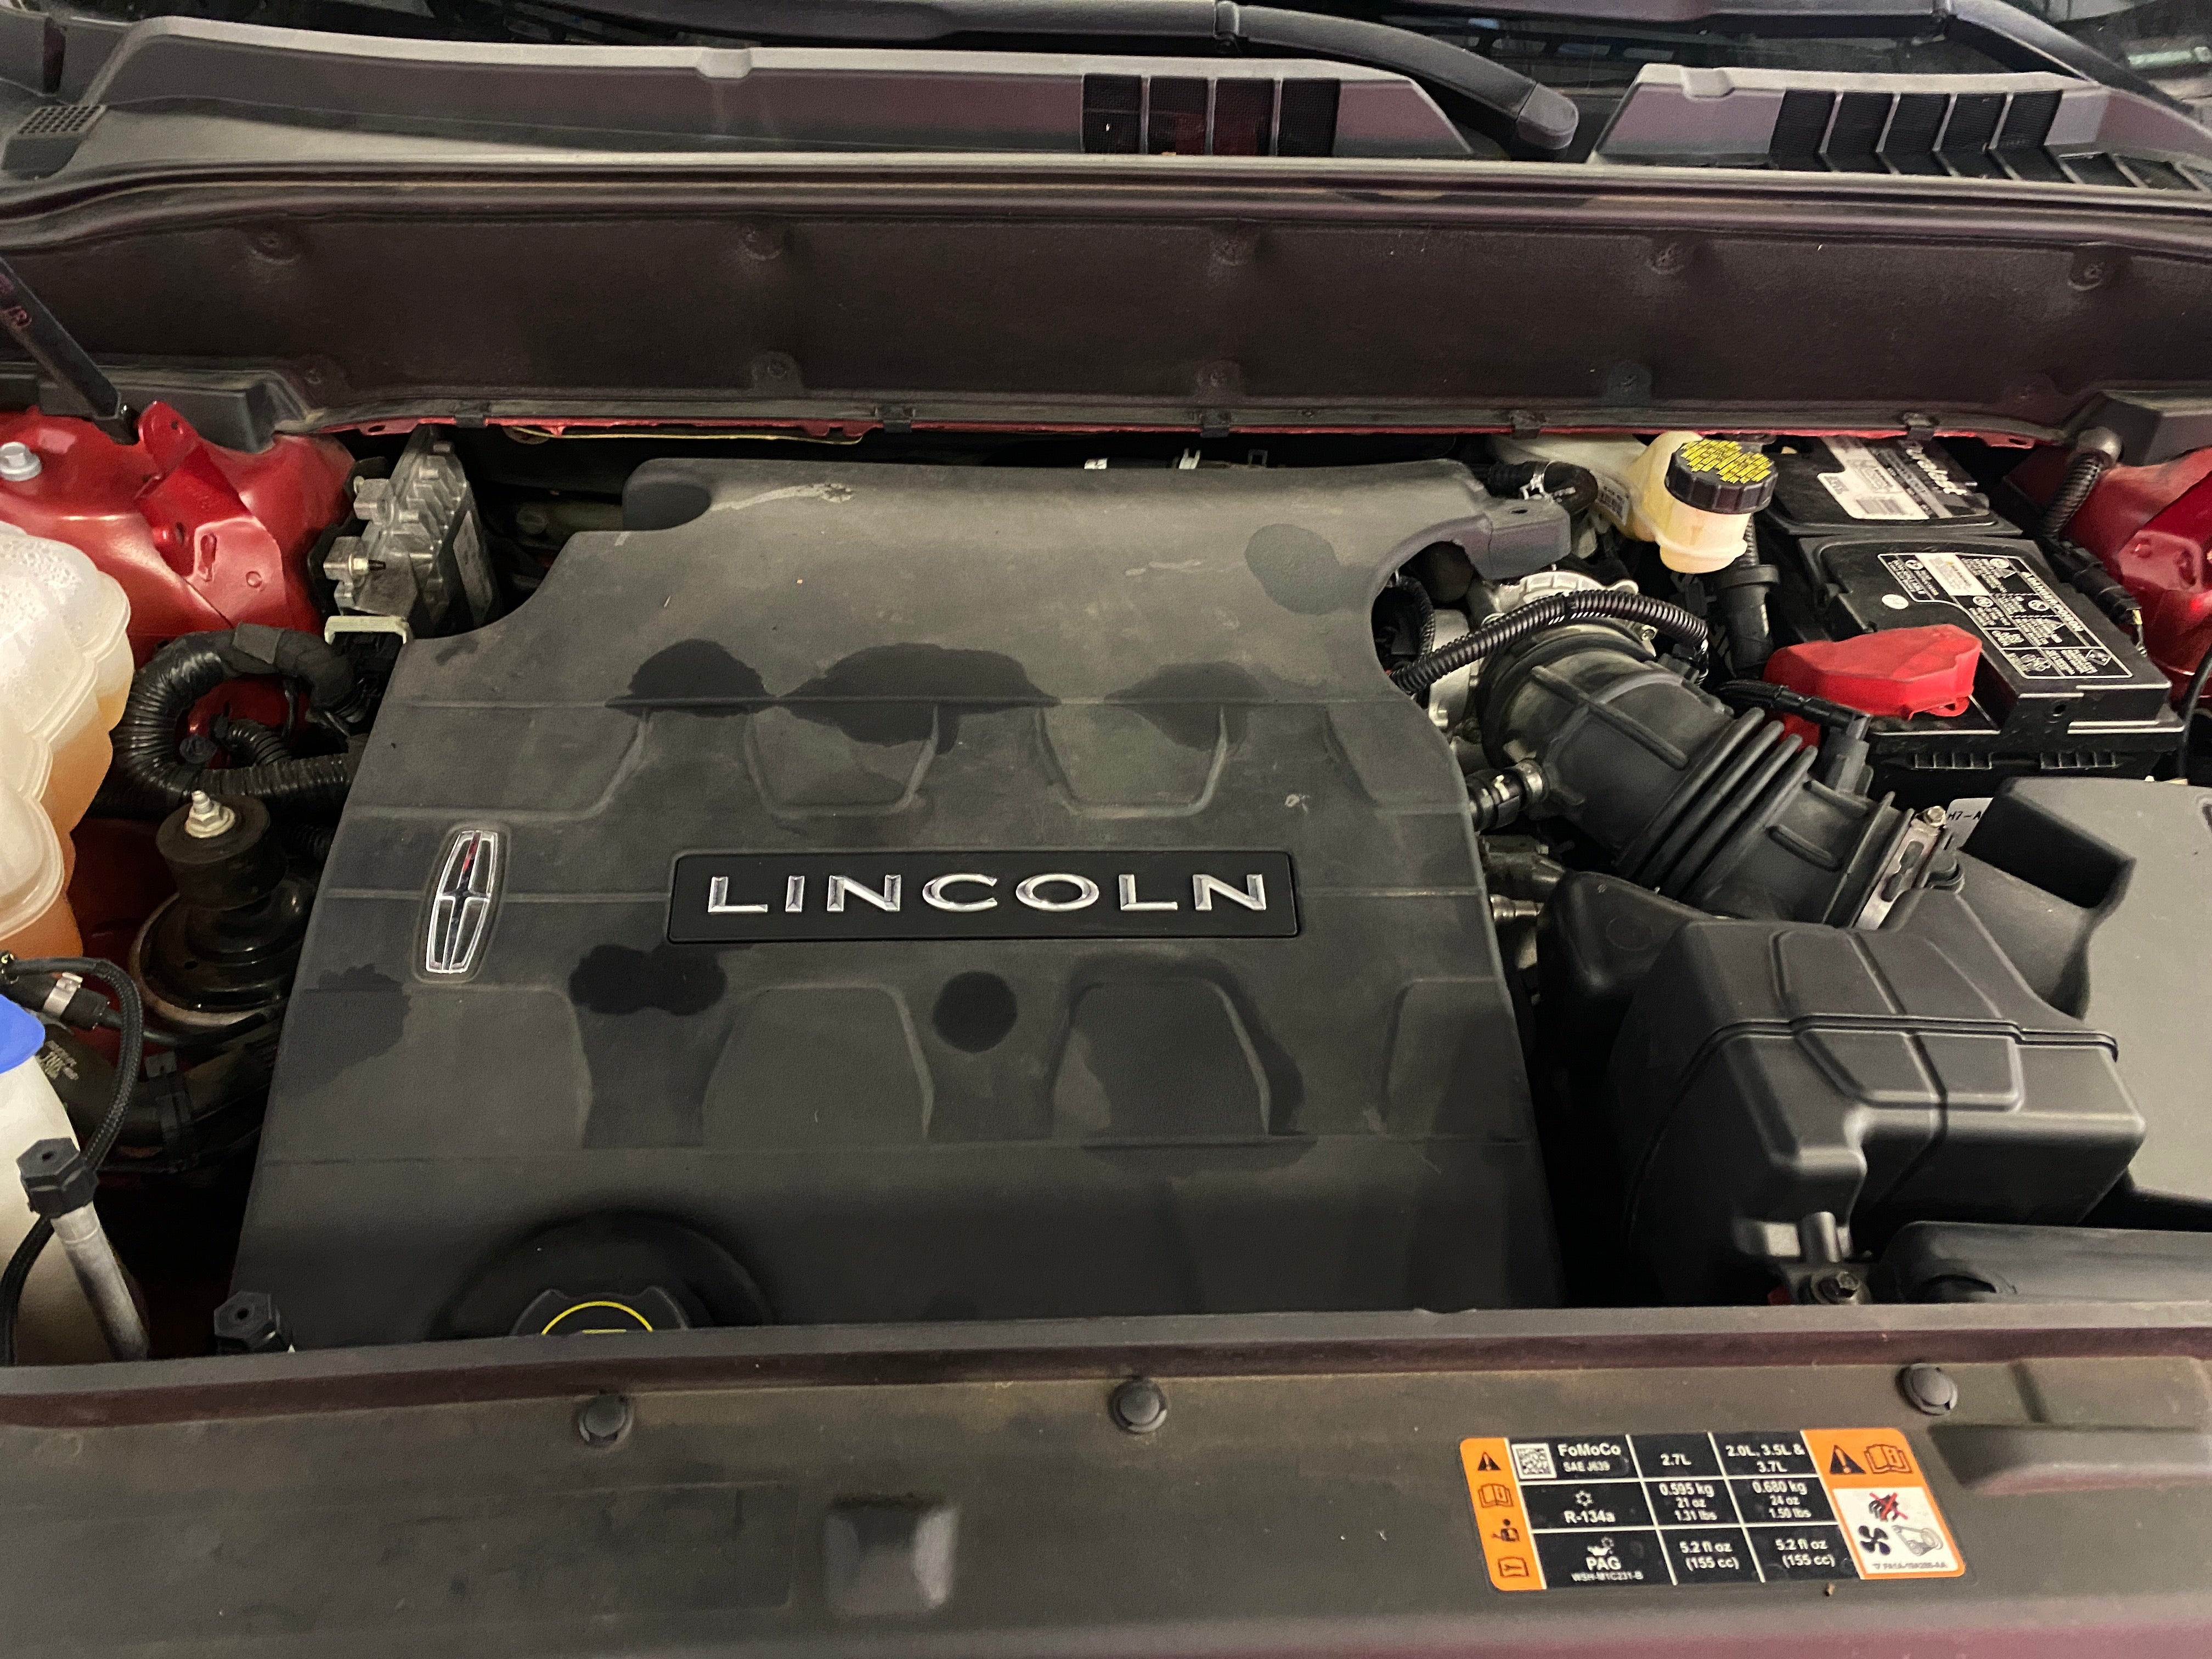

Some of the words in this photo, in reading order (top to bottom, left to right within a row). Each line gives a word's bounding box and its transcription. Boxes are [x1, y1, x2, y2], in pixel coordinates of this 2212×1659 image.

[707, 873, 1267, 913] LINCOLN
[1558, 1442, 1621, 1457] FoMoCo
[1725, 1445, 1760, 1457] 2.0L,
[1760, 1443, 1792, 1455] 3.5L
[1793, 1443, 1805, 1455] &
[1660, 1453, 1692, 1466] 2.7L
[1757, 1460, 1788, 1472] 3.7L
[1563, 1462, 1585, 1472] SAE
[1659, 1482, 1695, 1496] 0.595
[1695, 1482, 1714, 1497] kg
[1752, 1481, 1787, 1493] 0.680
[1788, 1480, 1808, 1495] kg
[1675, 1497, 1690, 1508] 21
[1692, 1498, 1706, 1508] oz
[1770, 1494, 1784, 1505] 24
[1786, 1496, 1800, 1505] oz
[1564, 1509, 1616, 1523] R-134a
[1674, 1510, 1697, 1521] 1.31
[1698, 1509, 1717, 1520] lbs
[1769, 1507, 1792, 1518] 1.50
[1792, 1507, 1812, 1517] lbs
[1679, 1541, 1700, 1553] 5.2
[1702, 1541, 1713, 1553] fl
[1714, 1543, 1733, 1553] oz
[1775, 1538, 1797, 1550] 5.2
[1797, 1538, 1809, 1550] fl
[1810, 1539, 1829, 1550] oz
[1585, 1556, 1622, 1571] PAG
[1685, 1556, 1716, 1571] (155
[1717, 1556, 1739, 1570] cc)
[1782, 1553, 1812, 1568] (155
[1813, 1553, 1836, 1567] cc)
